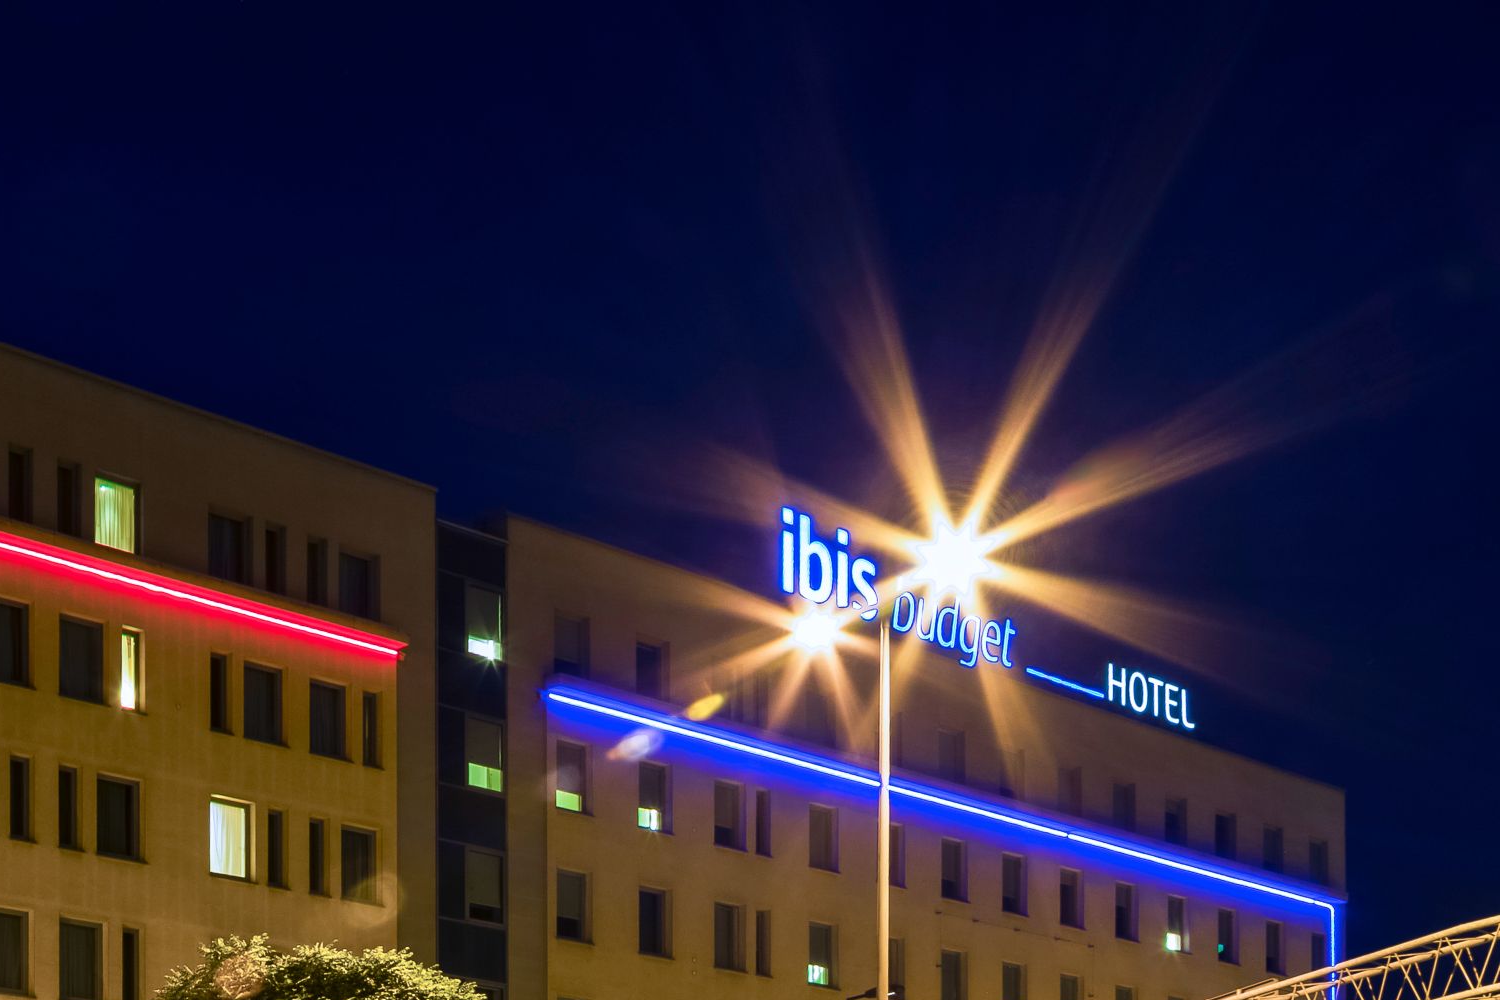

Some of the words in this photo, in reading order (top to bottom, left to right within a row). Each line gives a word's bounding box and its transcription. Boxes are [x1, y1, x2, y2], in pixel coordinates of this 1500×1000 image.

[781, 507, 879, 621] ibis
[892, 573, 1017, 668] budget
[1107, 662, 1196, 729] HOTEL
